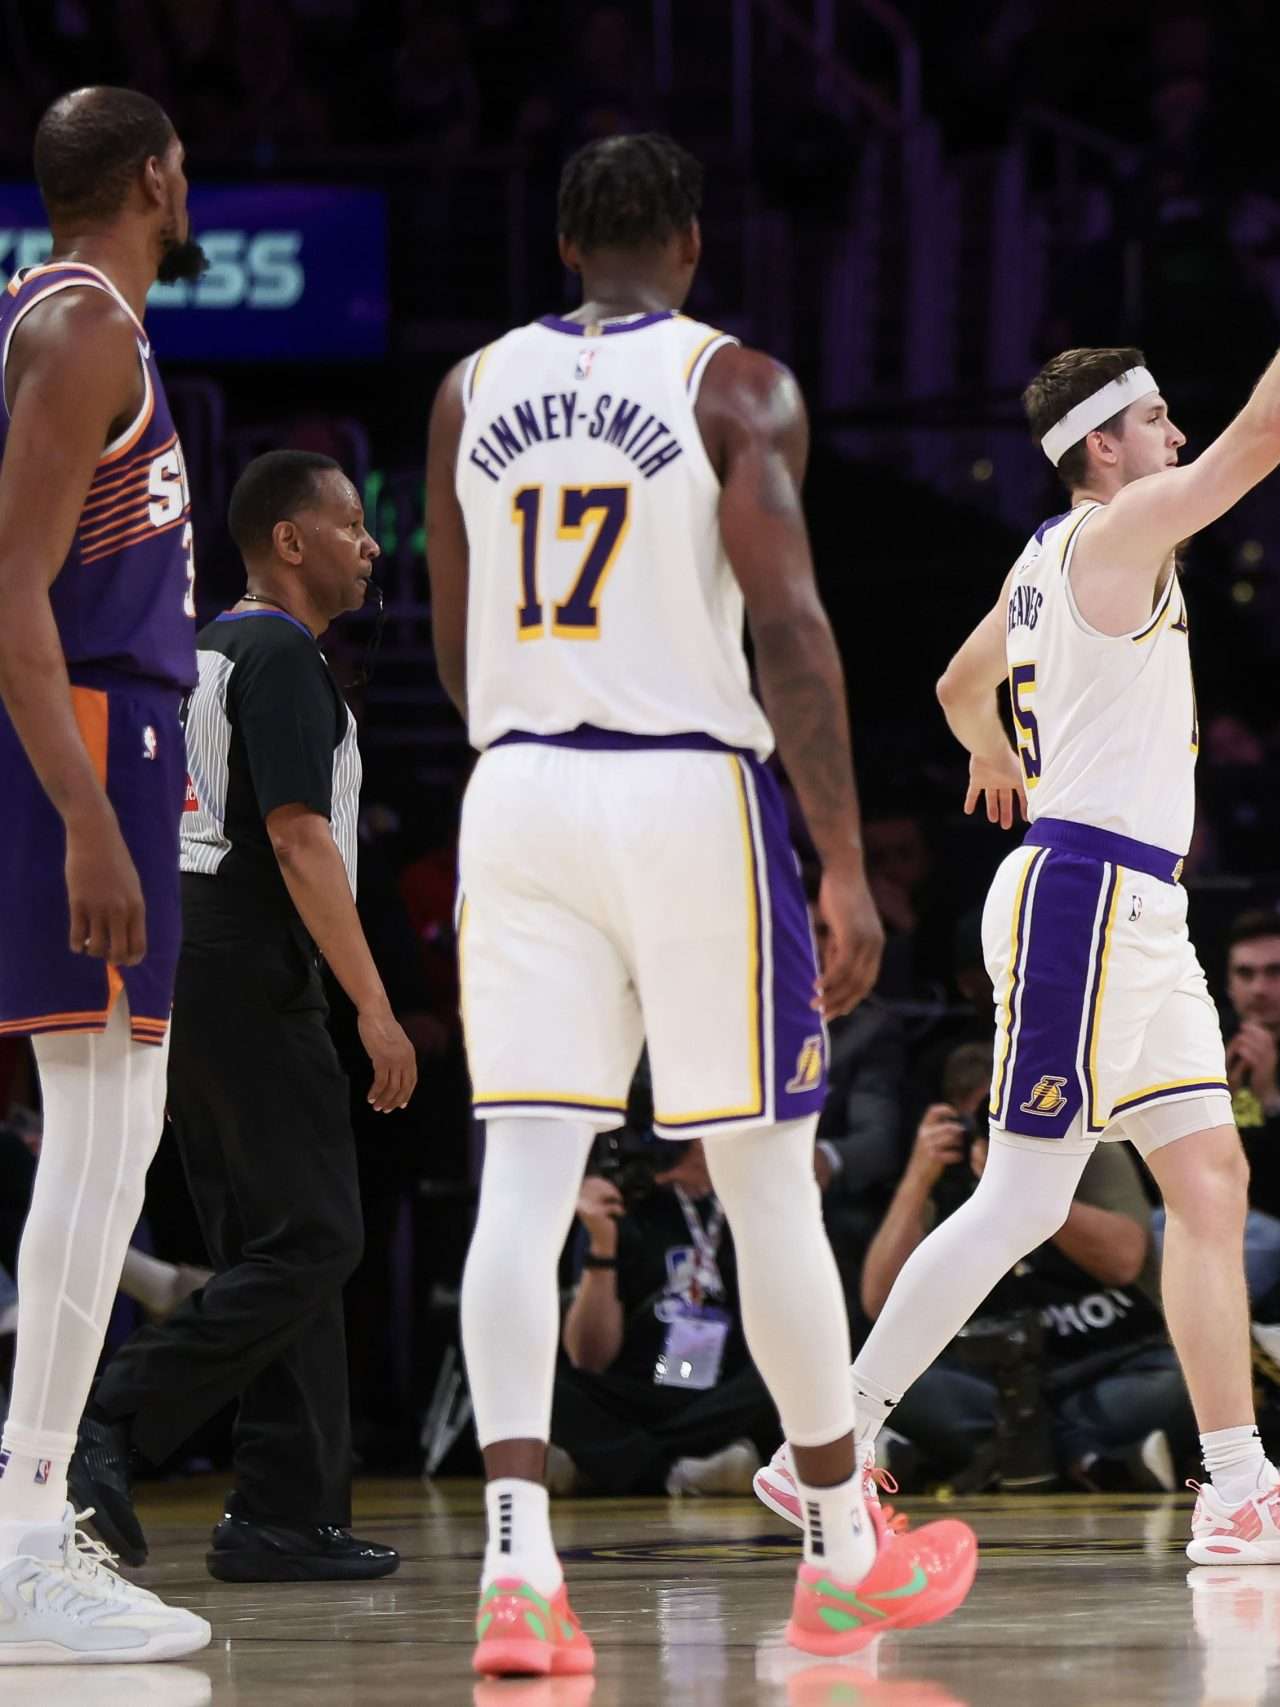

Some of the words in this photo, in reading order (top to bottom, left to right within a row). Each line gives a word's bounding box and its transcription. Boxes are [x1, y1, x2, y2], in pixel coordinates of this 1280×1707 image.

[148, 439, 191, 527] S
[470, 391, 683, 483] FINNEY-SMITH
[511, 481, 632, 642] 17
